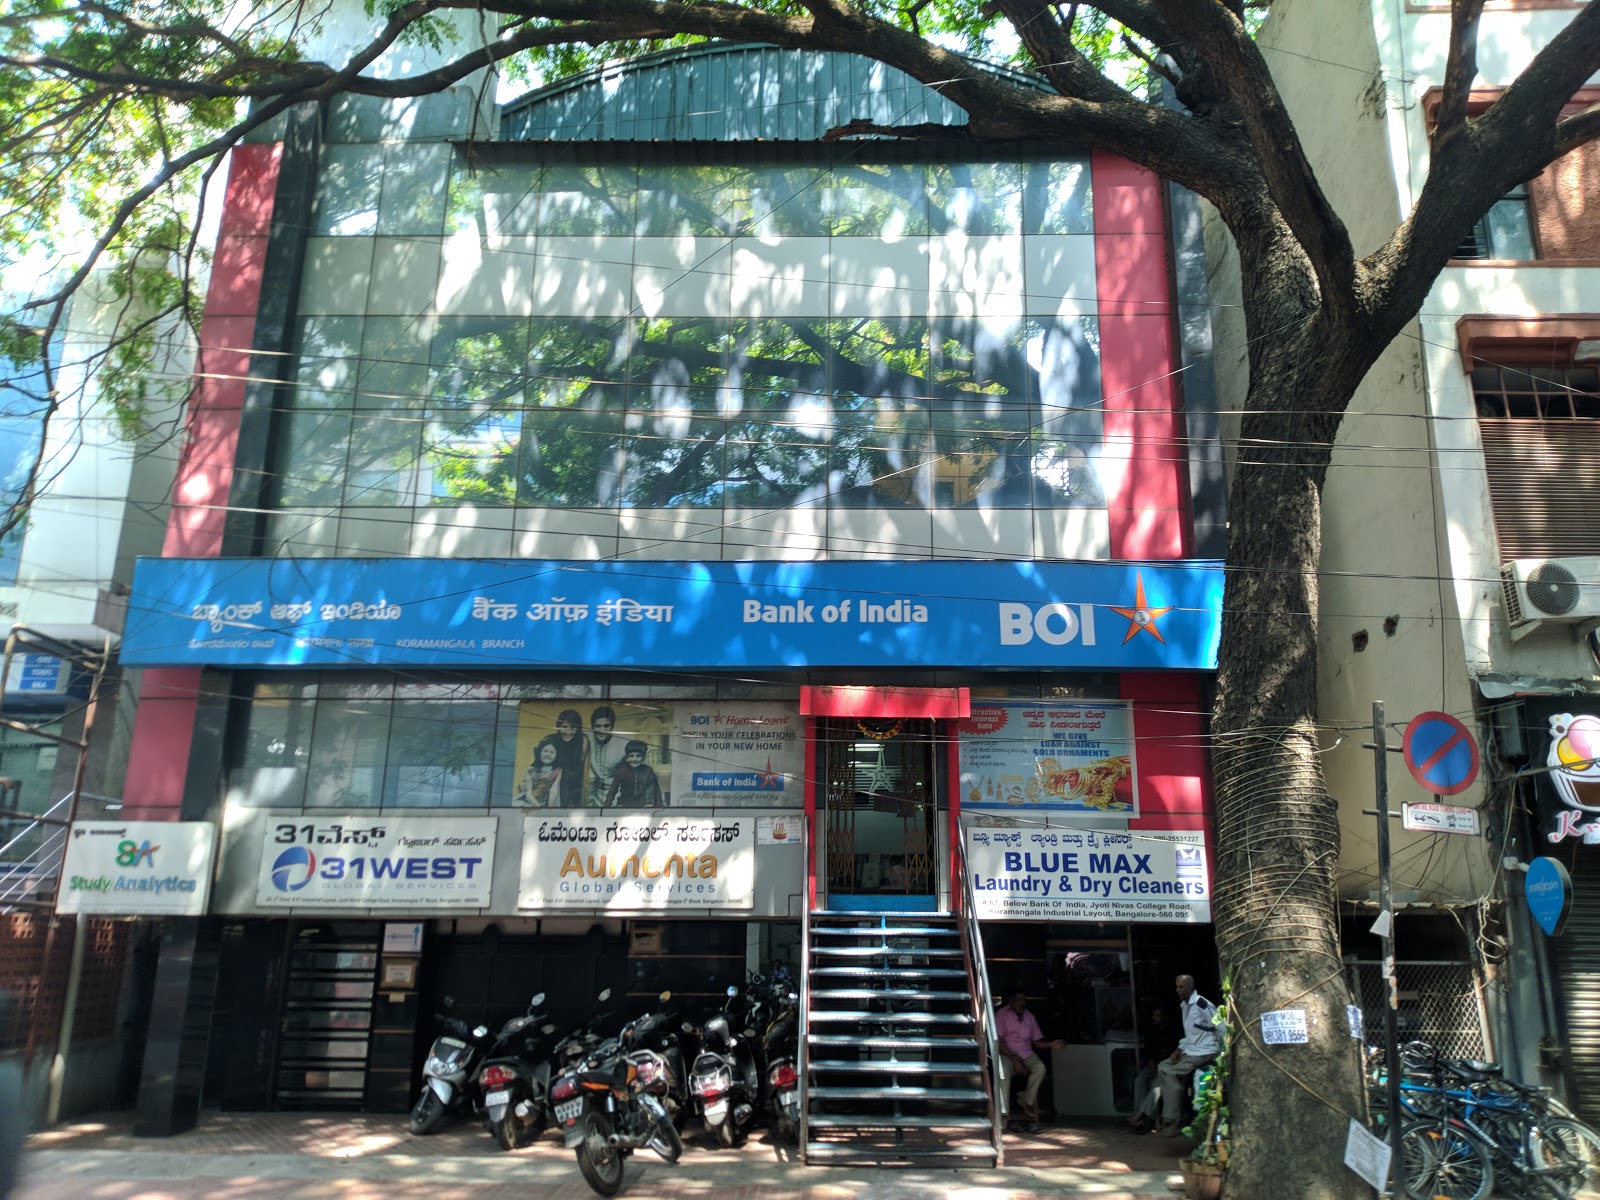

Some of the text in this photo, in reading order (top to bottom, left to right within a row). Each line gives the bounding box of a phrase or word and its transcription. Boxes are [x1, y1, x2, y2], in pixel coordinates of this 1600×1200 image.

[472, 596, 518, 621] बैंक
[596, 598, 674, 626] इंडिया
[743, 599, 929, 624] Bank of India
[1000, 602, 1096, 646] BOI
[396, 638, 524, 649] KORAMANGALA BRANCH
[690, 716, 709, 725] BOI
[971, 715, 998, 723] Interest
[710, 731, 734, 739] YOUR
[736, 731, 797, 739] CELEBRATIONS
[696, 742, 783, 750] IN YOUR NEW HOME
[1064, 741, 1101, 749] AGAINST
[1057, 749, 1110, 757] ORNAMENTS
[697, 777, 757, 787] Bank of India
[1062, 834, 1083, 847] ಮತ್ತು
[320, 857, 483, 879] 31WEST
[1004, 852, 1153, 874] BLUE MAX
[70, 875, 196, 893] Study Analytics
[560, 881, 621, 893] Global
[974, 873, 1204, 897] Laundry & Dry Cleaners
[1002, 900, 1028, 908] Below
[1030, 900, 1050, 908] Bank
[1066, 901, 1088, 909] India,
[1090, 901, 1112, 910] Jyoti
[1137, 902, 1166, 912] College
[1169, 903, 1193, 911] Road,
[1043, 909, 1081, 917] Industrial
[1083, 909, 1113, 918] Layout,
[1115, 910, 1173, 919] Bangalore-560
